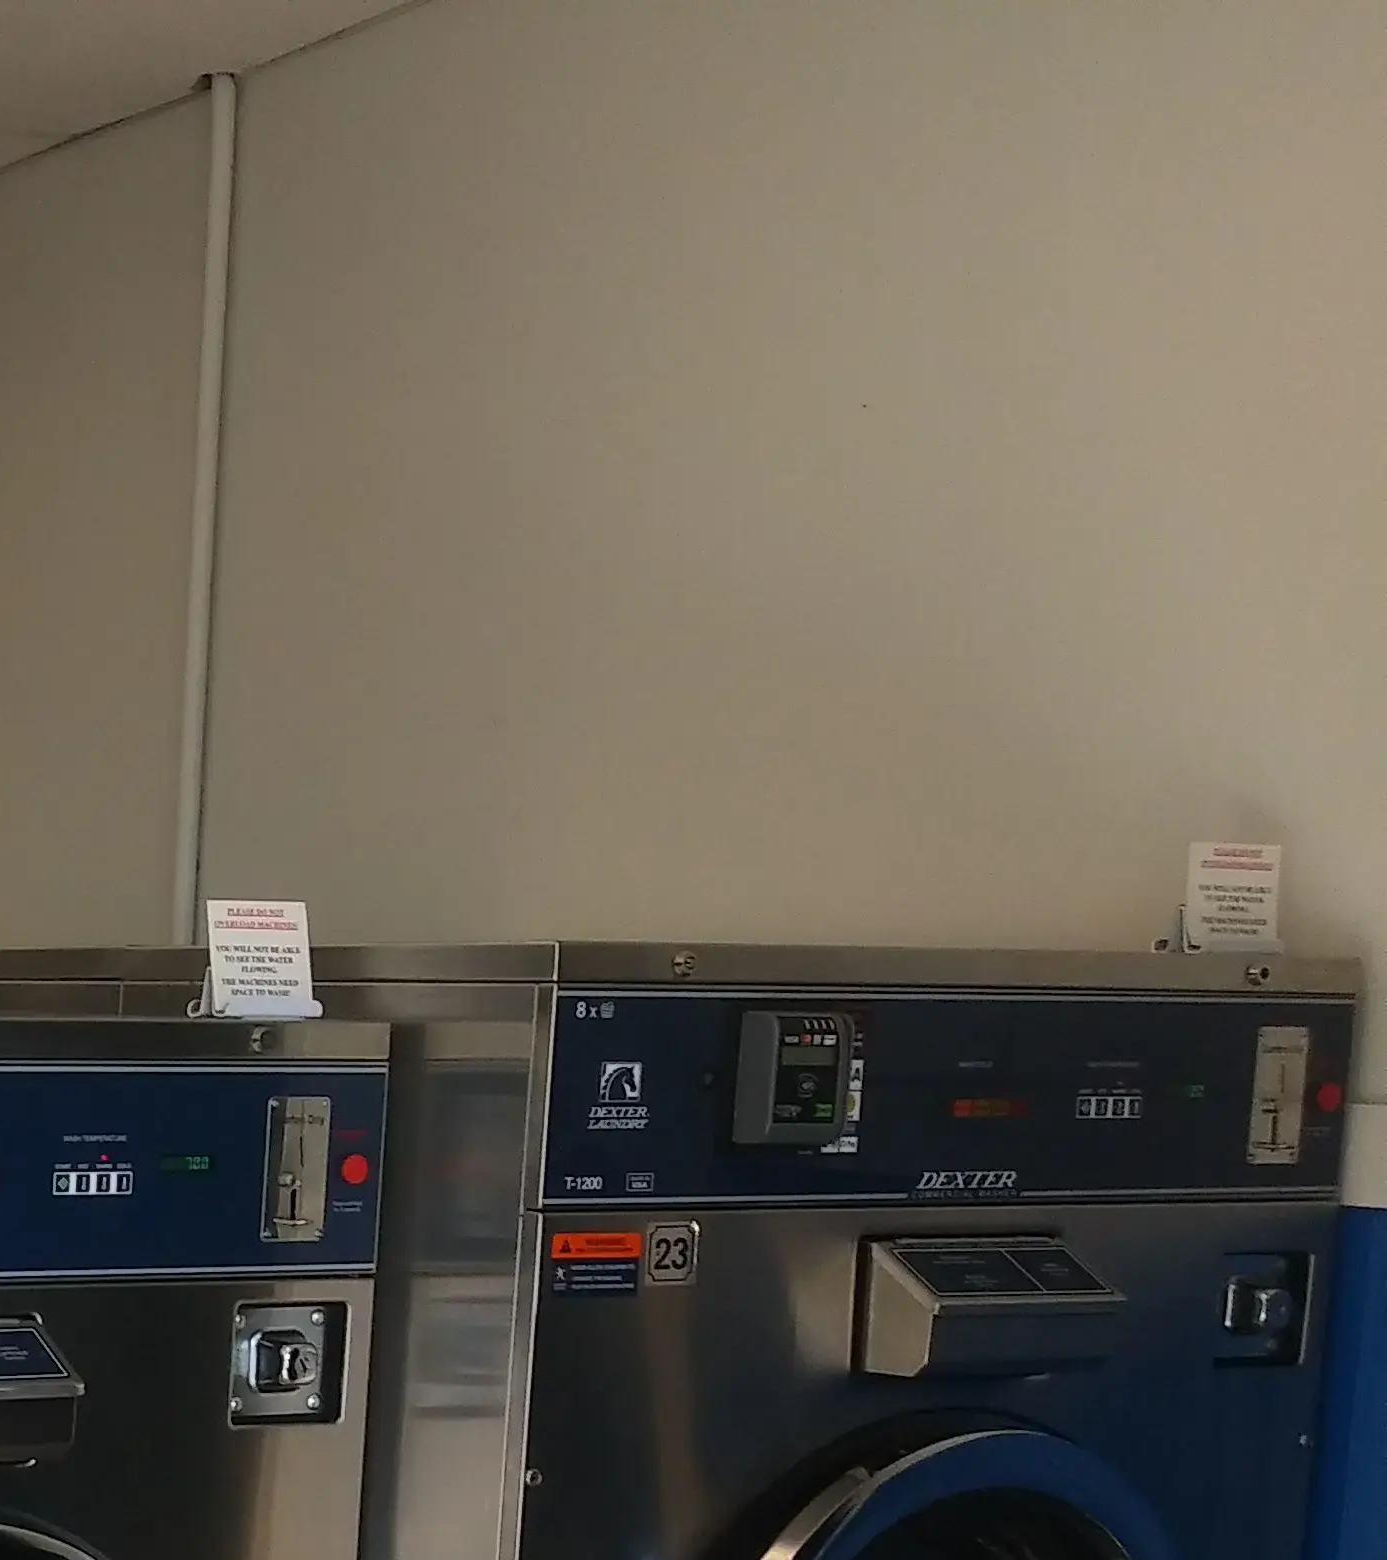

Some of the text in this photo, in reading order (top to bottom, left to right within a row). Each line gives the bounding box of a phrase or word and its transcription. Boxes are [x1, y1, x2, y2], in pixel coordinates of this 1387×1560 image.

[233, 945, 252, 953] WILL
[268, 956, 294, 964] WATER
[238, 978, 278, 986] MACHINES
[575, 1001, 598, 1019] 8 x
[588, 1106, 650, 1118] DEXTER
[587, 1118, 650, 1129] LAUNDRY
[564, 1176, 604, 1190] T-1200
[915, 1170, 1018, 1190] DEXTER
[654, 1237, 690, 1270] 23
